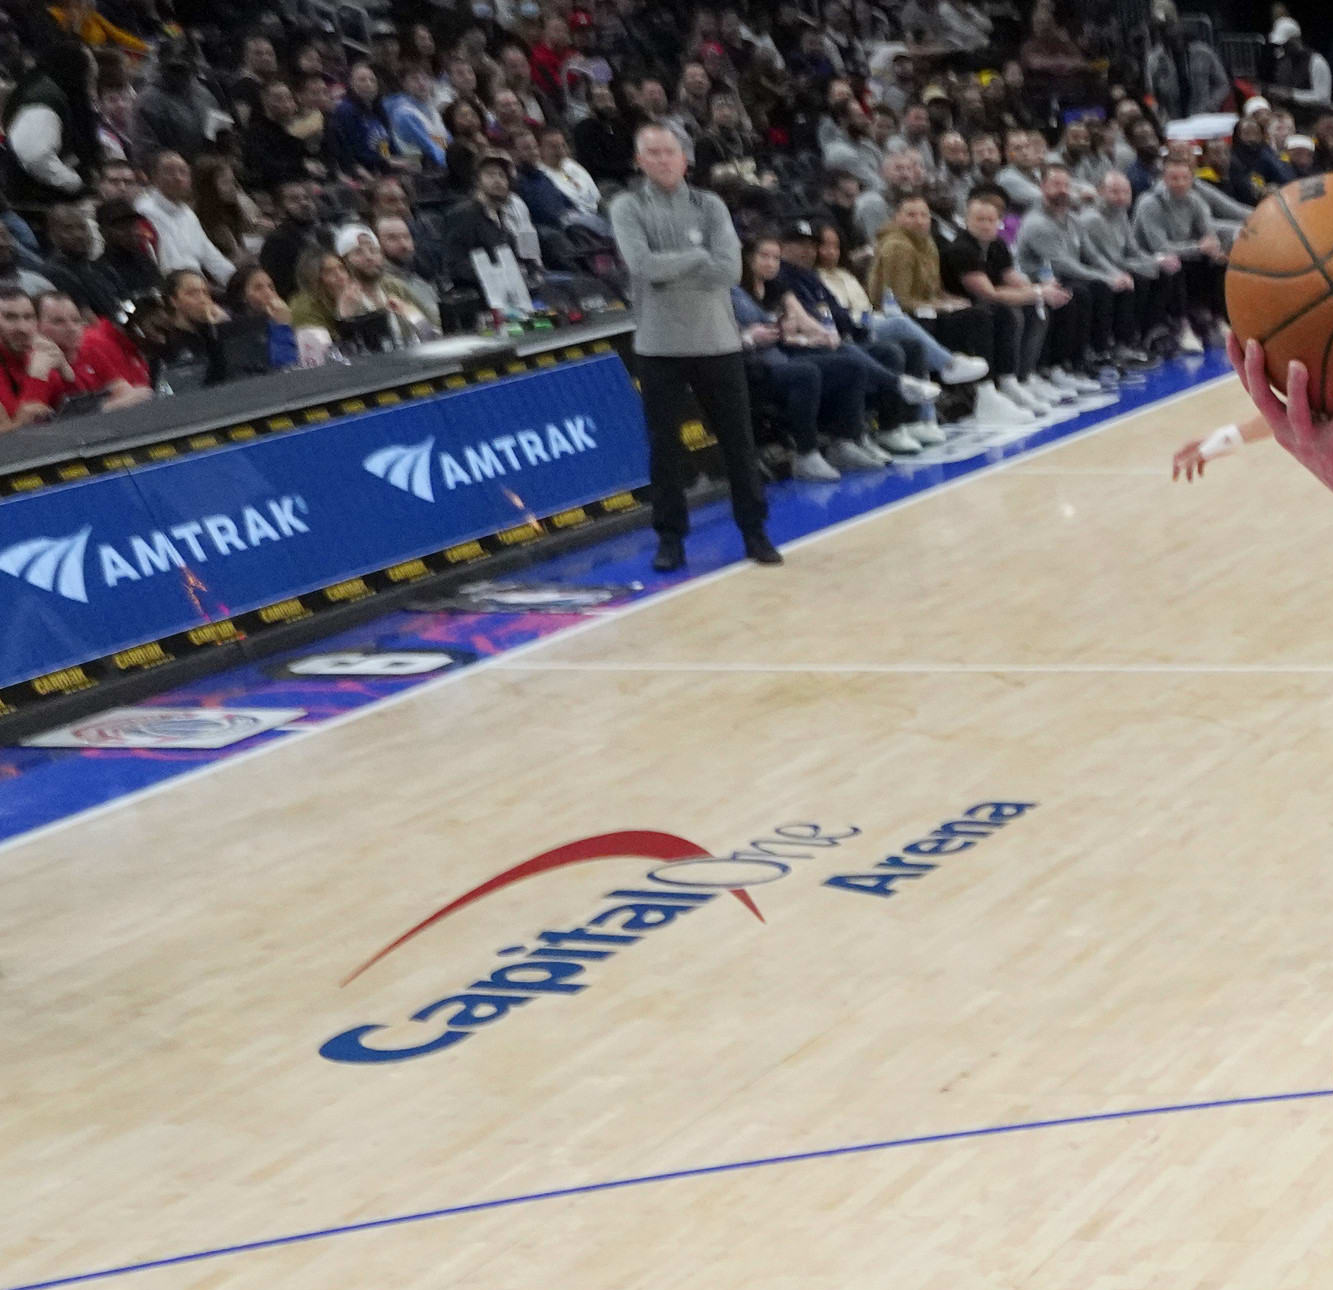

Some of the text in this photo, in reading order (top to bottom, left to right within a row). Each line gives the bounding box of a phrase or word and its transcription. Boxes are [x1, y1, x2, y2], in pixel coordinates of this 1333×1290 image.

[438, 414, 598, 490] AMTRAK
[99, 496, 310, 588] AMTRAK
[820, 800, 1037, 899] Arena
